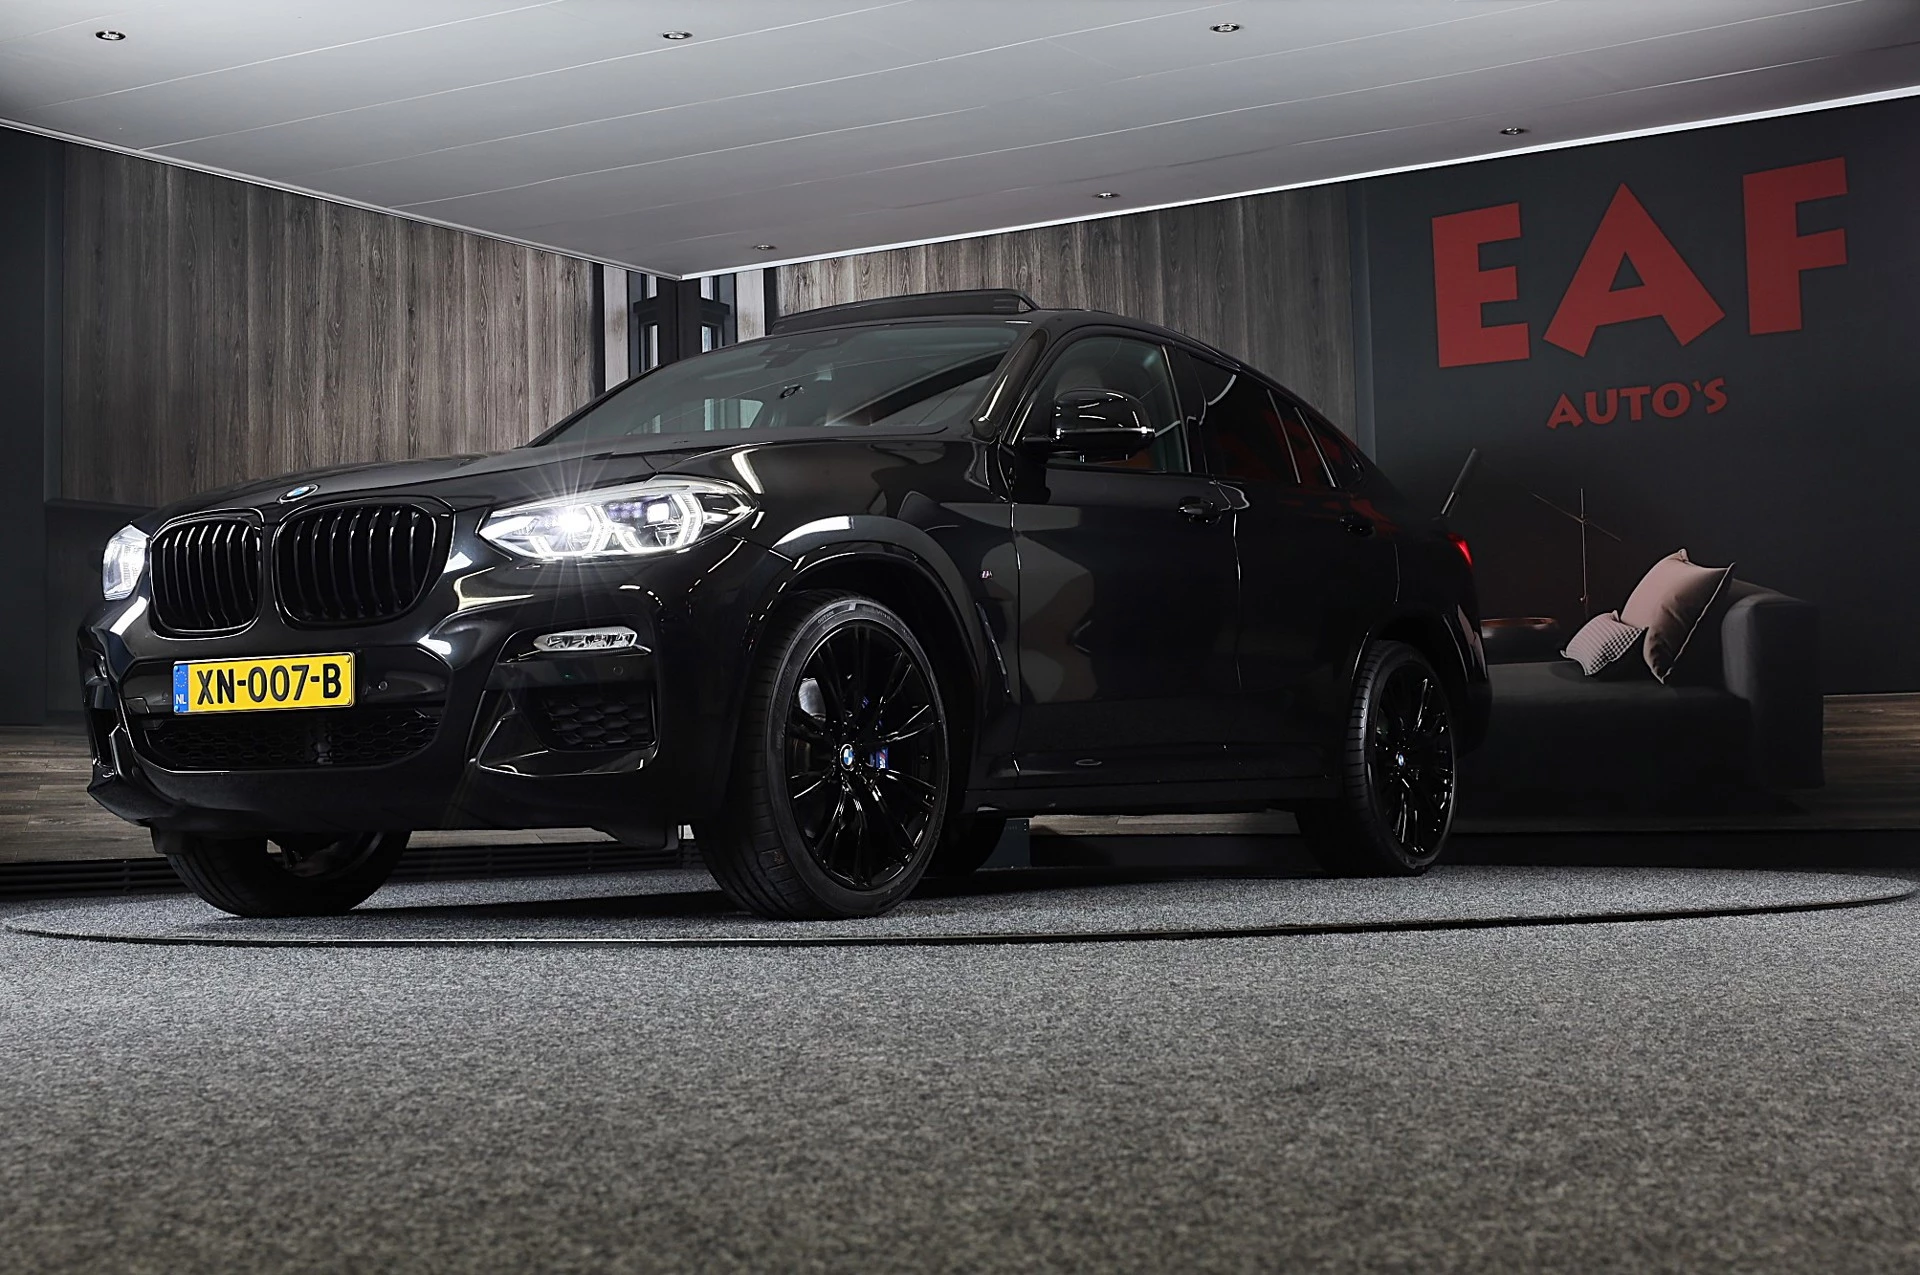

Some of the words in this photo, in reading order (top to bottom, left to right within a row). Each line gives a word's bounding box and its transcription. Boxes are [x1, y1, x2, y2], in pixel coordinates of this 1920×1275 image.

[1431, 156, 1848, 368] EAF
[1546, 377, 1728, 429] AUTO'S
[175, 694, 187, 705] NL
[196, 663, 342, 705] XN-007-B
